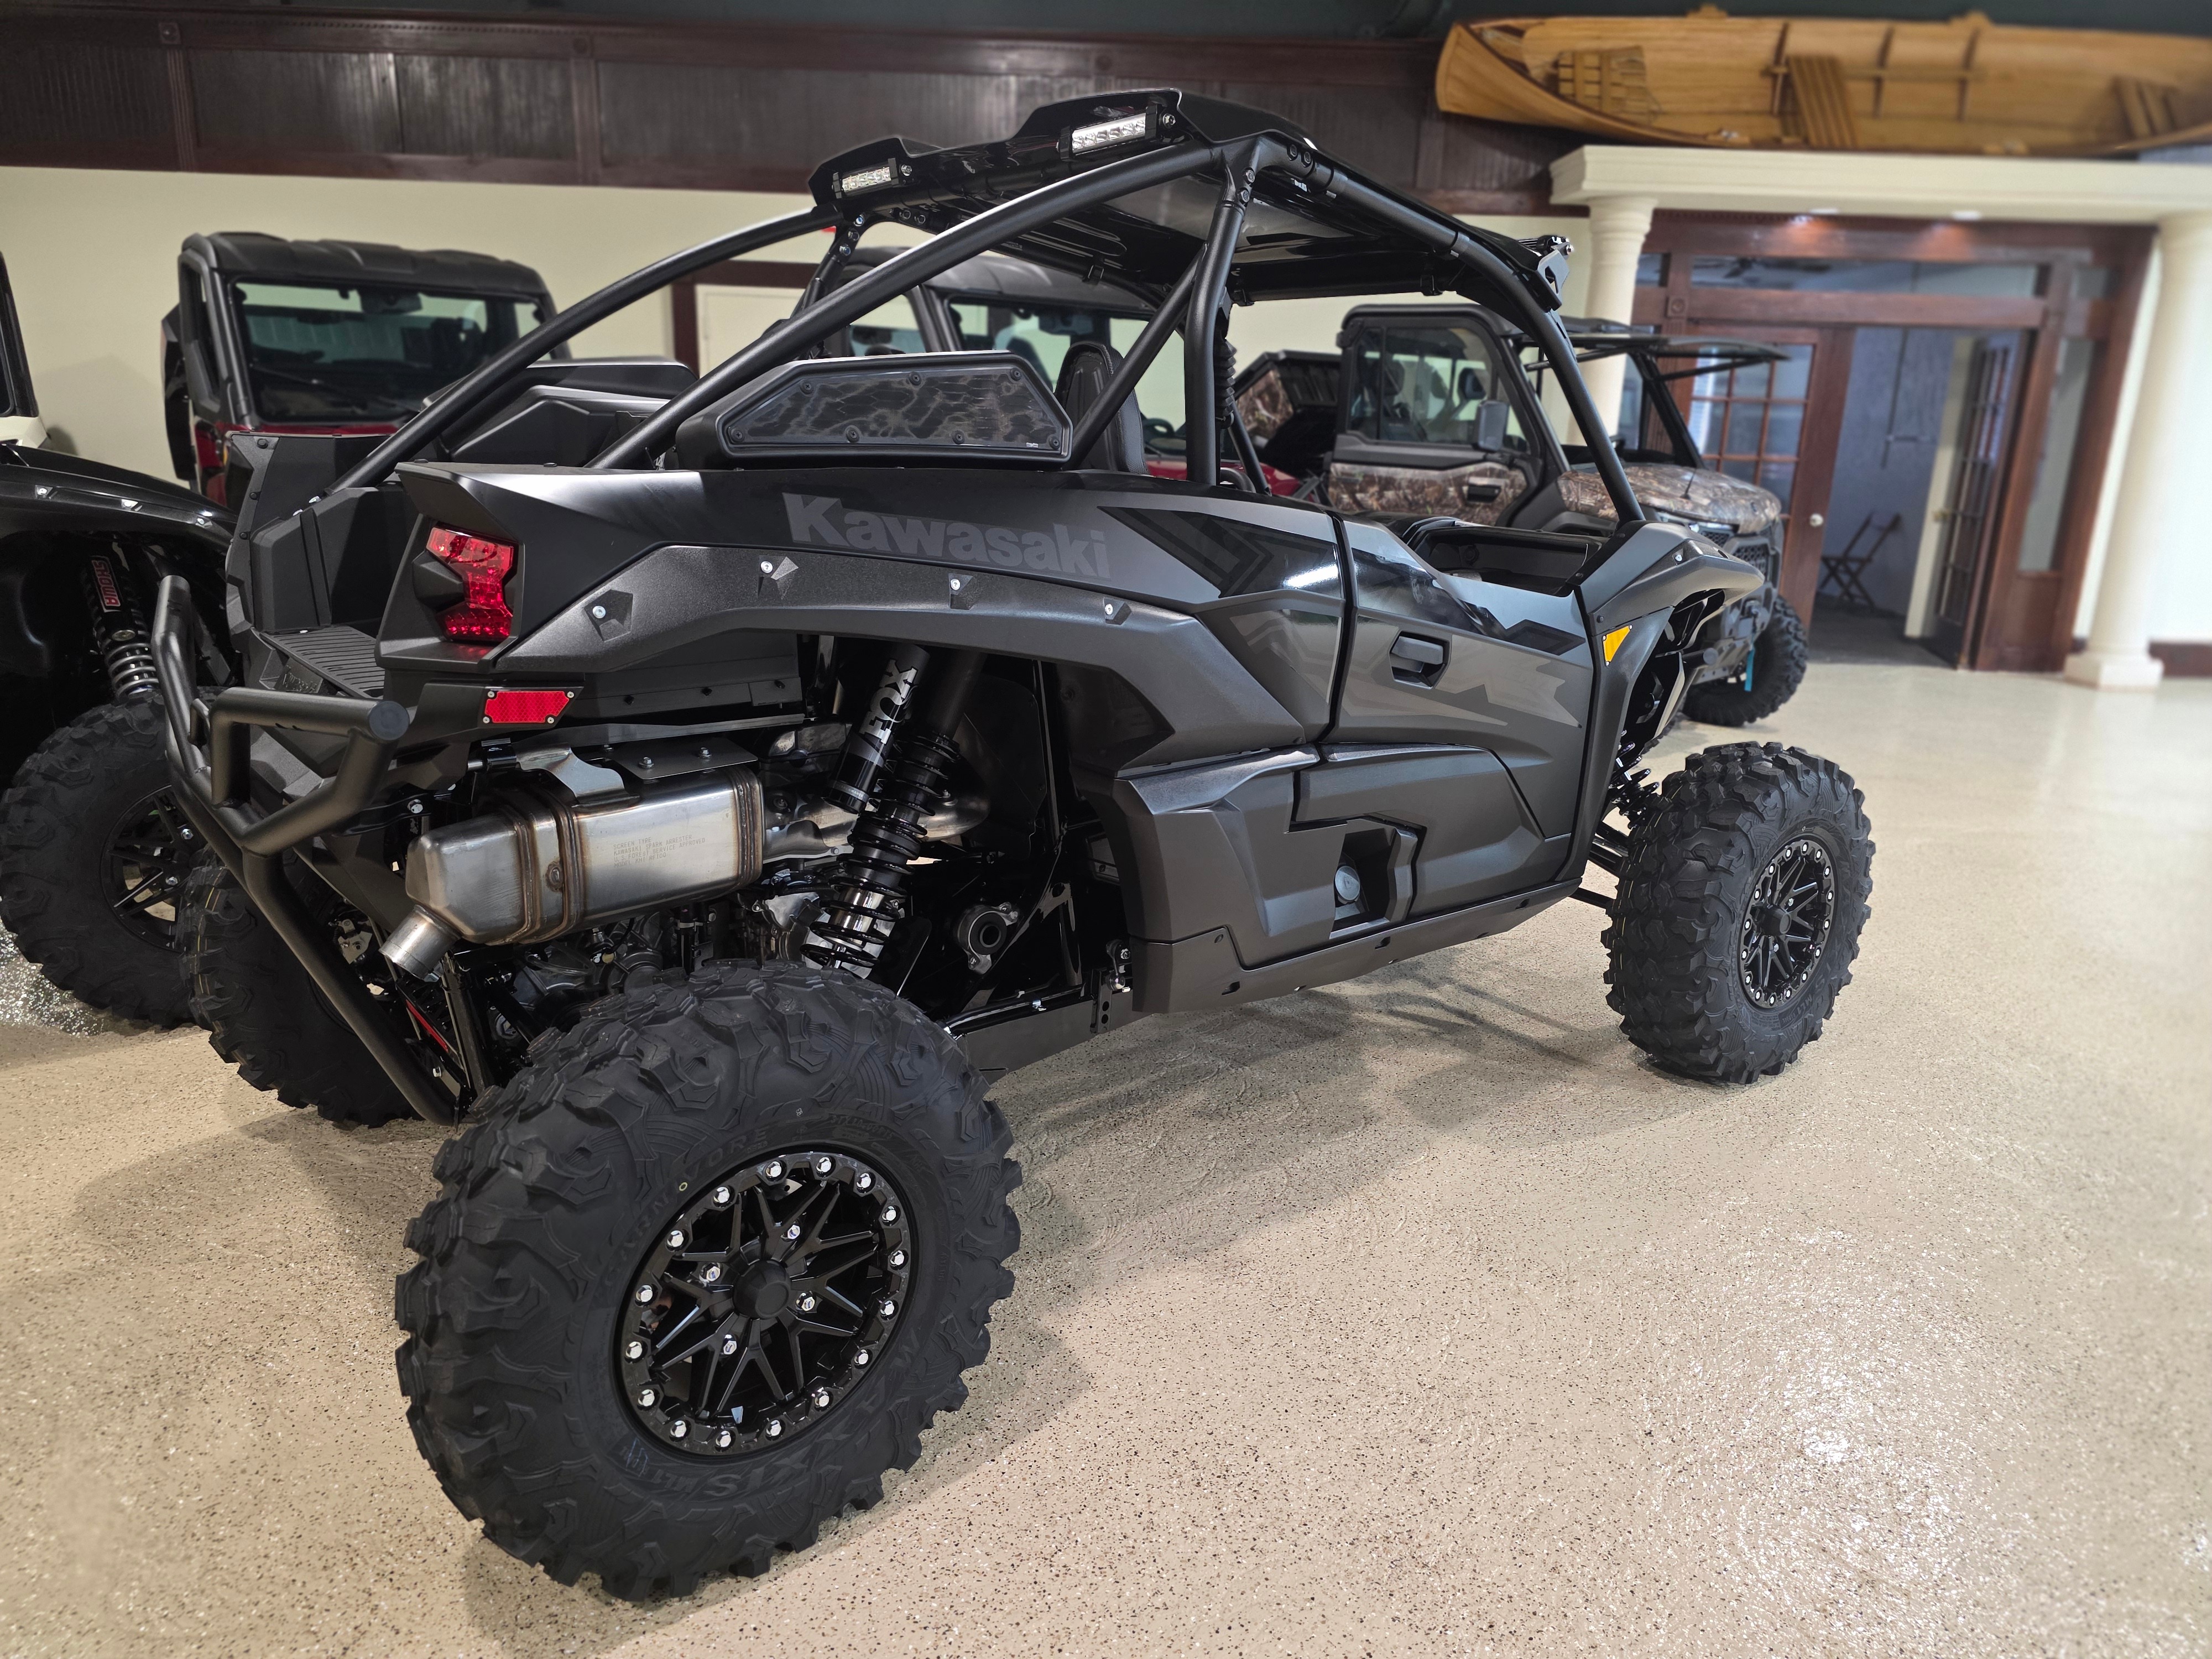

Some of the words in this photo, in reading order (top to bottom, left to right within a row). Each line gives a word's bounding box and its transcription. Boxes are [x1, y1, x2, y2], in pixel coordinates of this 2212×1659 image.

[782, 492, 1111, 580] Kawasaki
[91, 559, 121, 607] SHOWA
[859, 658, 919, 745] FOX
[613, 840, 635, 850] SCREEN
[638, 837, 652, 845] TYPE
[613, 846, 641, 856] KAWASAKI
[645, 842, 662, 850] SPARK
[665, 834, 692, 845] ARRESTER
[679, 837, 706, 848] APPROVED
